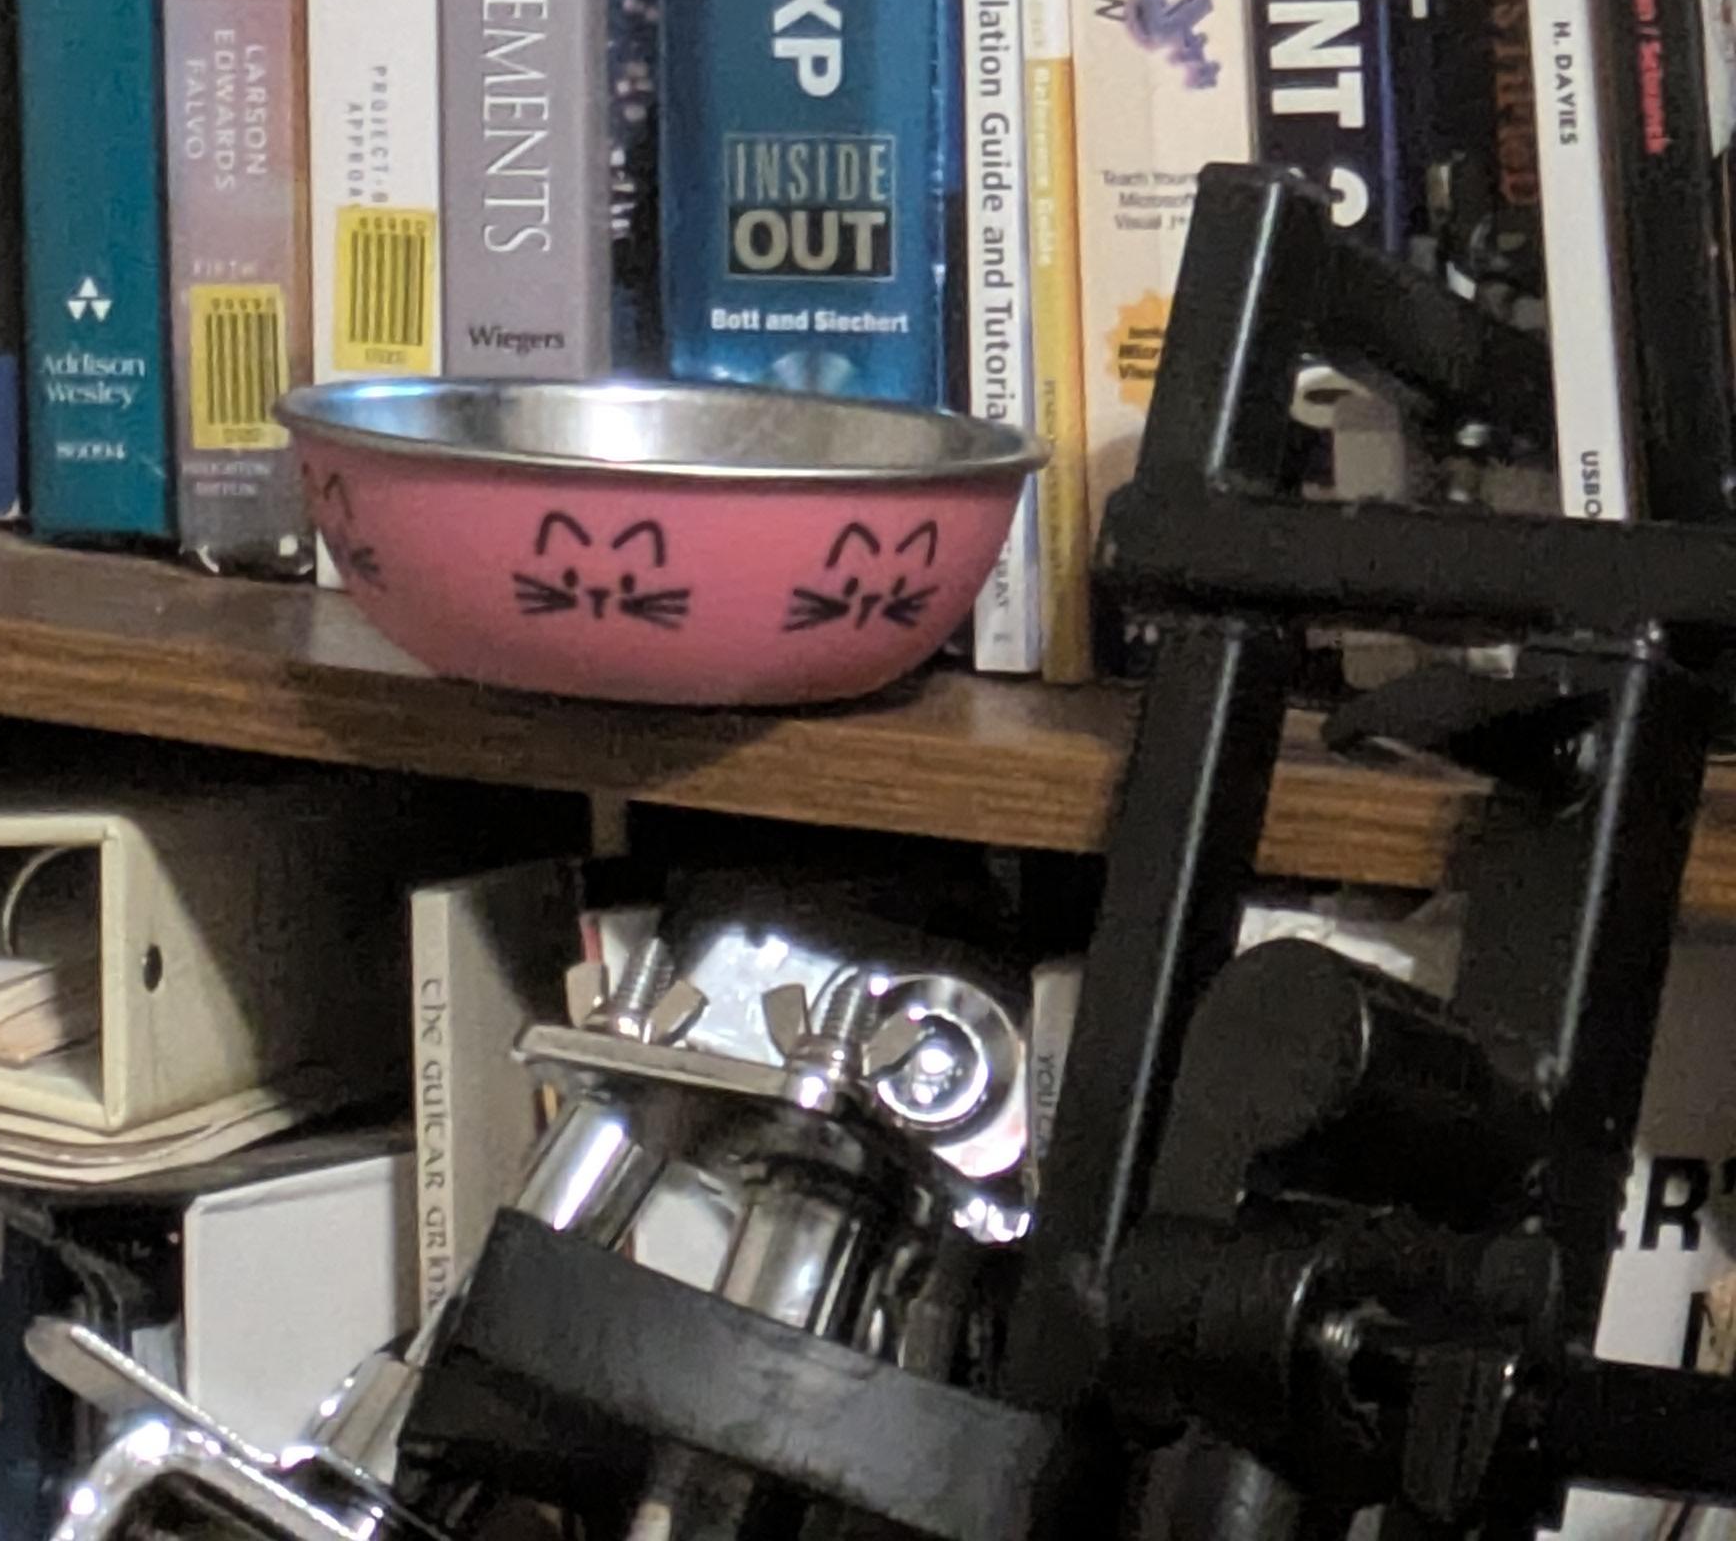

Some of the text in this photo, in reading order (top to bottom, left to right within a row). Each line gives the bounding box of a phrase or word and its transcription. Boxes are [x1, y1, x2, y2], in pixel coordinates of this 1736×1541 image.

[184, 59, 205, 161] FALVO
[213, 28, 237, 192] EDWARDS
[244, 43, 269, 176] LARSON
[1551, 21, 1578, 147] H. DAVIES
[734, 141, 888, 202] INSIDE
[980, 111, 1012, 213] Guide
[1033, 66, 1057, 269] Reference Guide
[732, 209, 888, 272] OUT
[982, 226, 1014, 290] and
[467, 323, 565, 356] Wiegers
[710, 307, 909, 335] Bott and Siechert
[983, 299, 1016, 423] Tutoria
[1580, 450, 1603, 517] USBO
